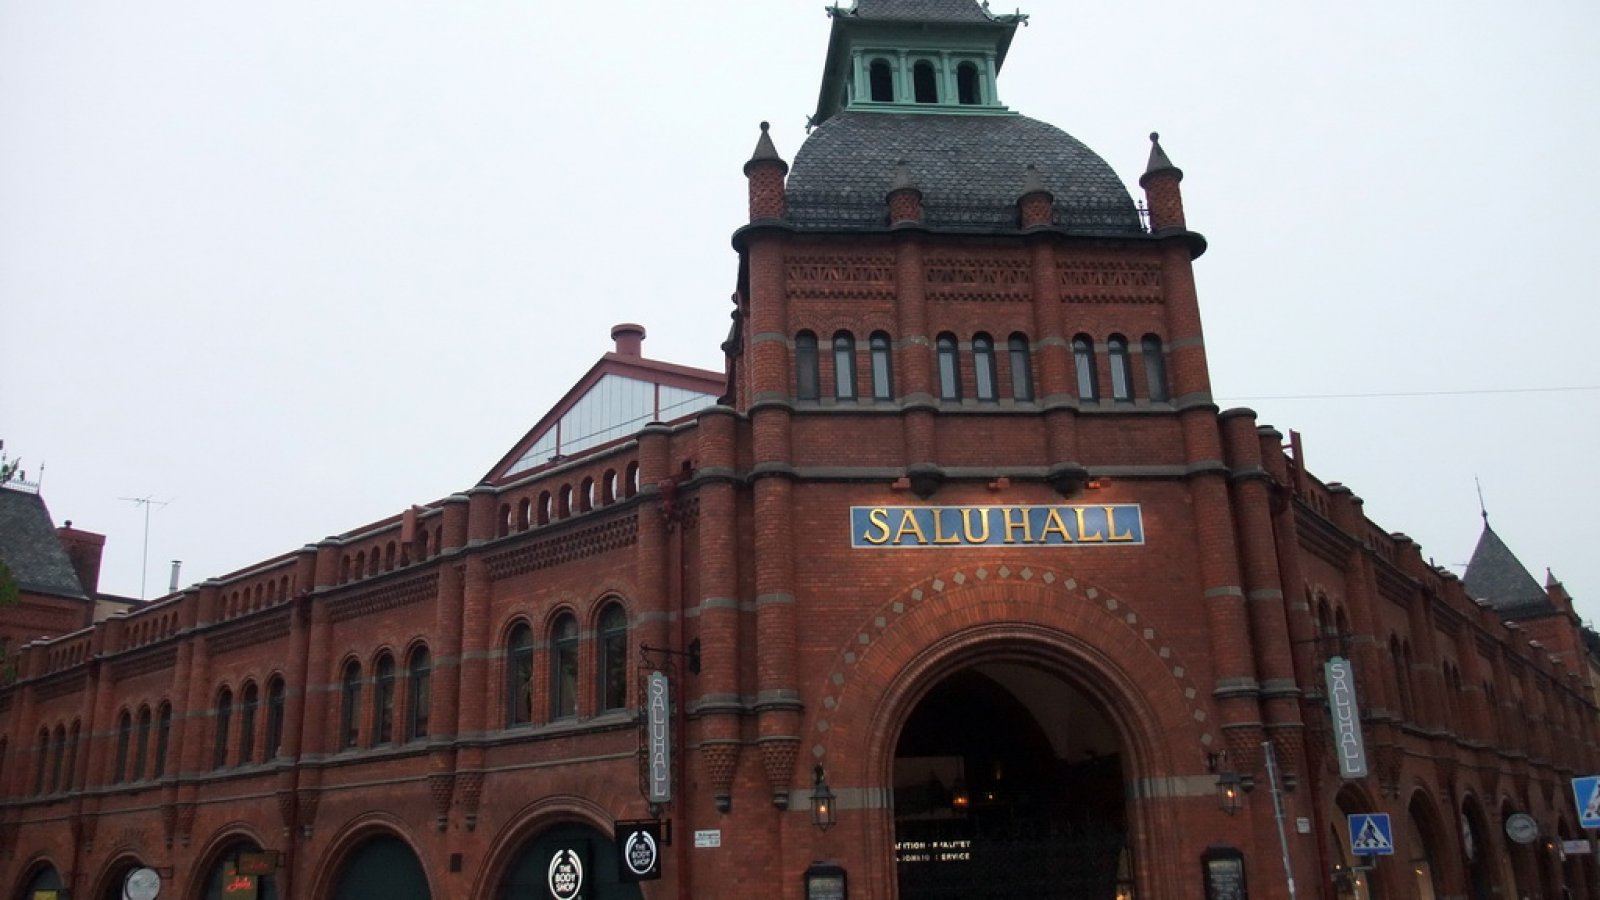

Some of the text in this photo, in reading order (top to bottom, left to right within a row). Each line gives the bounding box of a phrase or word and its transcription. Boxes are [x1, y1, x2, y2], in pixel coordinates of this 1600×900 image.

[864, 508, 1134, 544] SALUHALL
[1330, 663, 1360, 773] SALUHALL
[651, 679, 666, 796] SALUHALL
[635, 843, 646, 851] THE
[632, 850, 651, 860] BODY
[555, 872, 576, 882] BODY
[555, 882, 576, 892] SHOP
